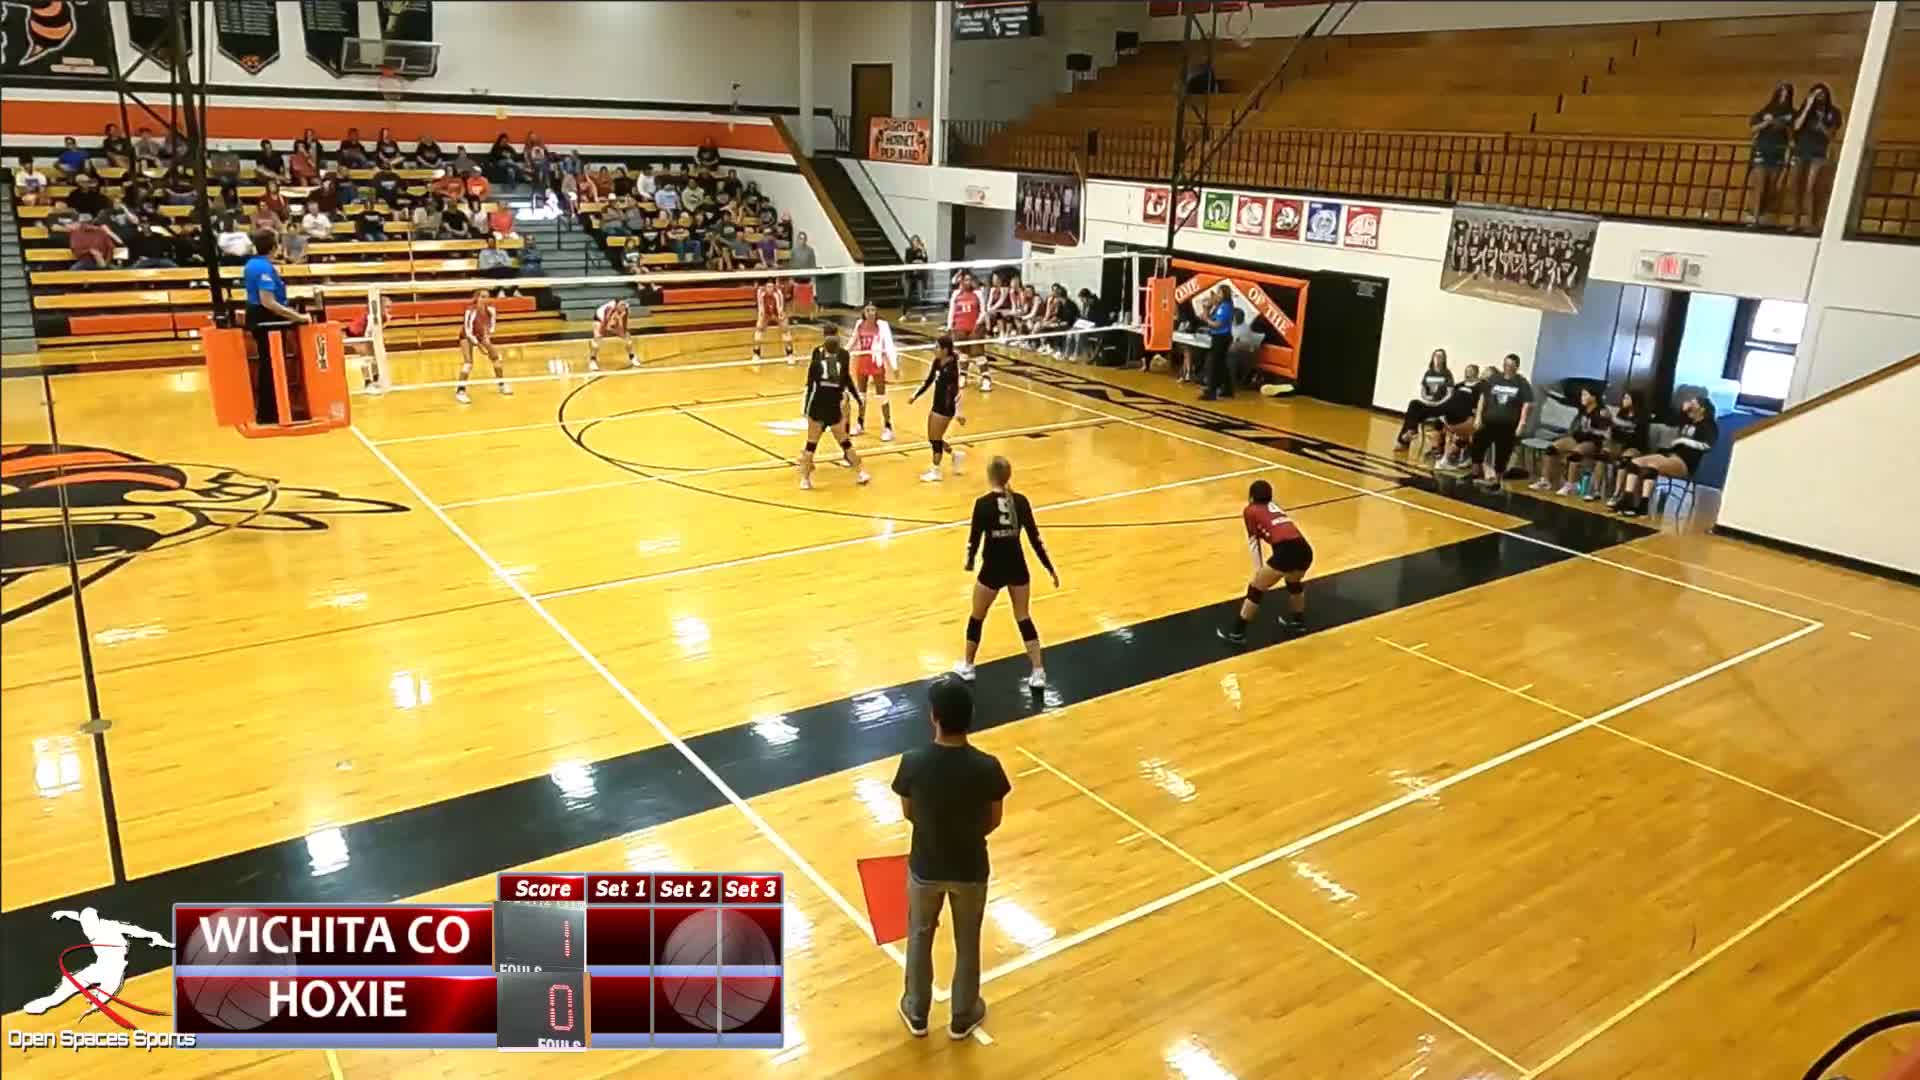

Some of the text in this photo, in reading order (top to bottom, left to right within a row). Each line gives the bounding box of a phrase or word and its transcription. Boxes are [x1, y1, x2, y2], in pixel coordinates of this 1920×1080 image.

[1174, 276, 1290, 337] OME OF THE
